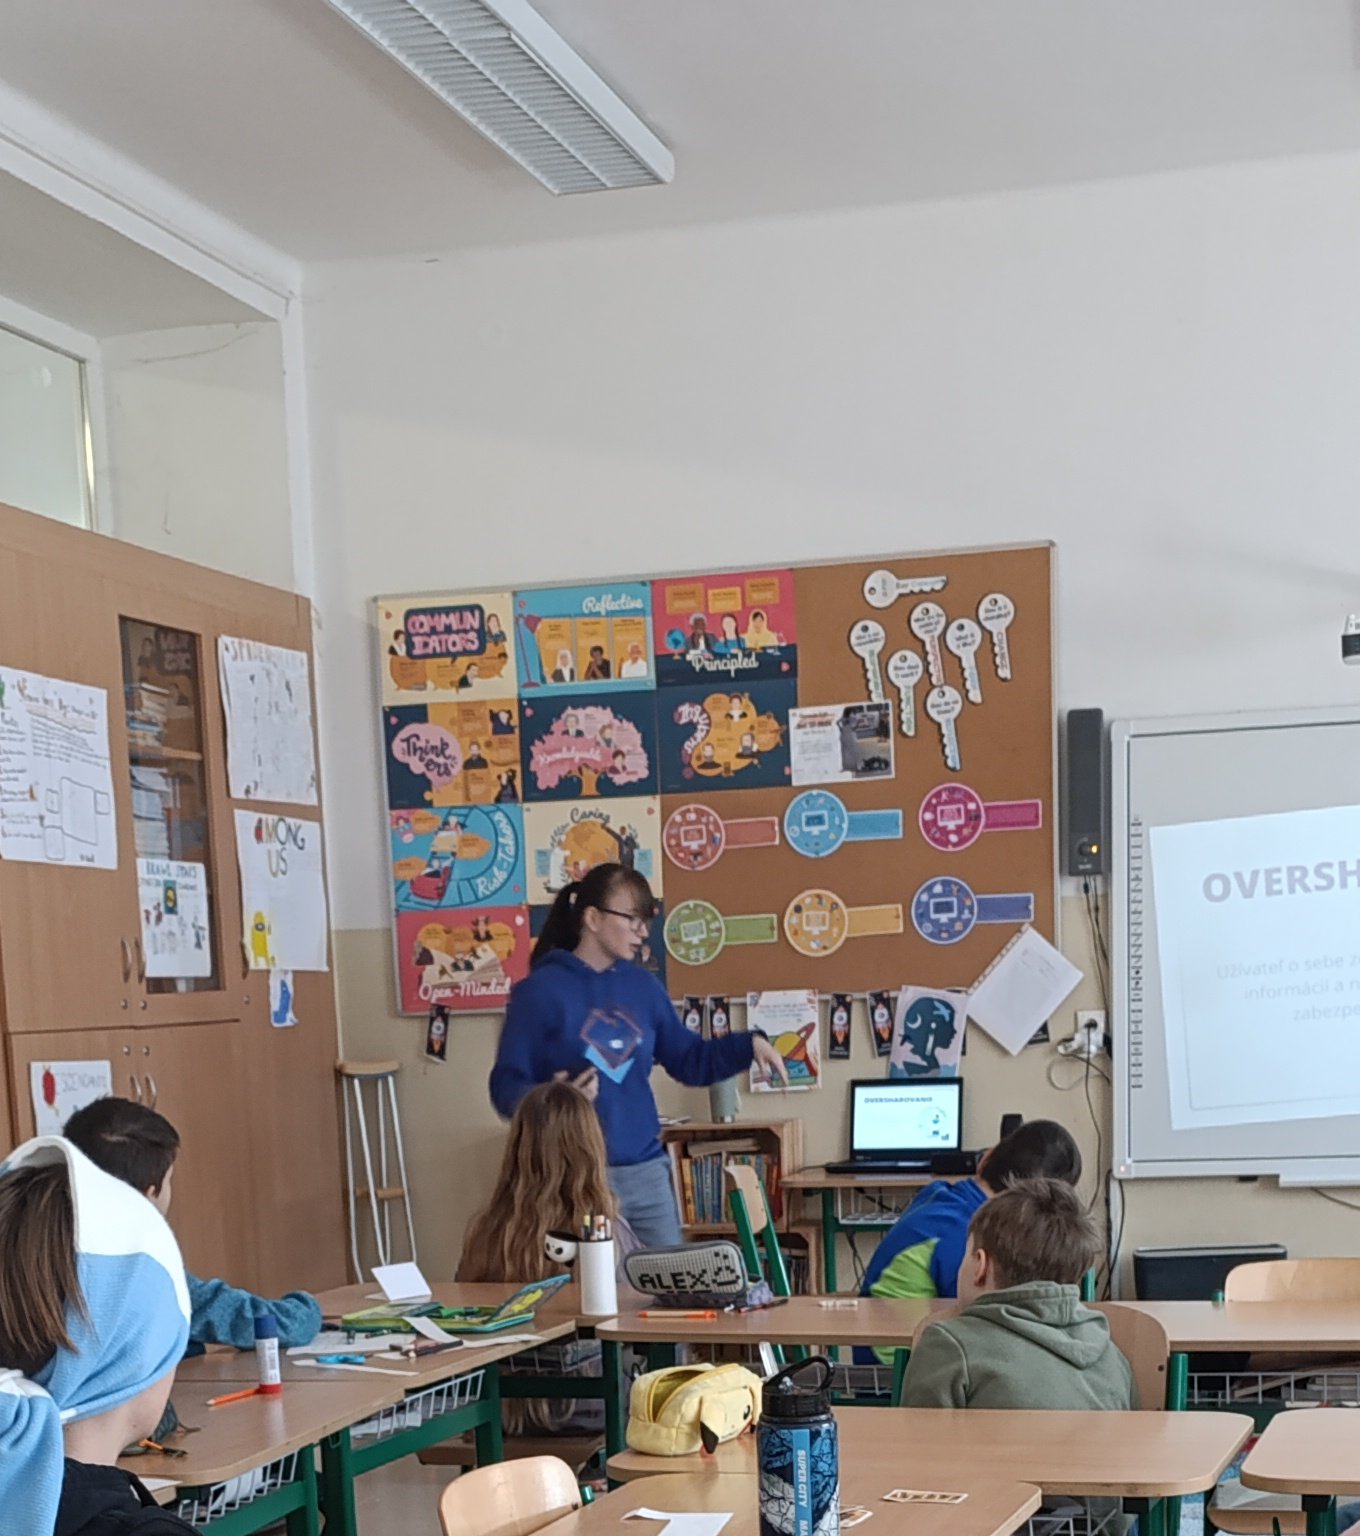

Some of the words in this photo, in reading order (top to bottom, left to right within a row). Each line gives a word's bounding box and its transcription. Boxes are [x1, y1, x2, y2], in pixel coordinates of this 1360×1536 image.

[582, 593, 644, 616] Reflective
[407, 609, 480, 634] COMMUN
[685, 648, 760, 678] Principled
[400, 733, 453, 762] Think
[570, 807, 611, 824] Caring
[267, 846, 289, 878] US
[1304, 954, 1344, 972] sebe
[418, 976, 512, 1004] Open-Minded
[1334, 982, 1344, 993] a
[640, 1268, 708, 1291] ALEX
[797, 1450, 808, 1482] SUPER
[798, 1483, 809, 1508] CITY
